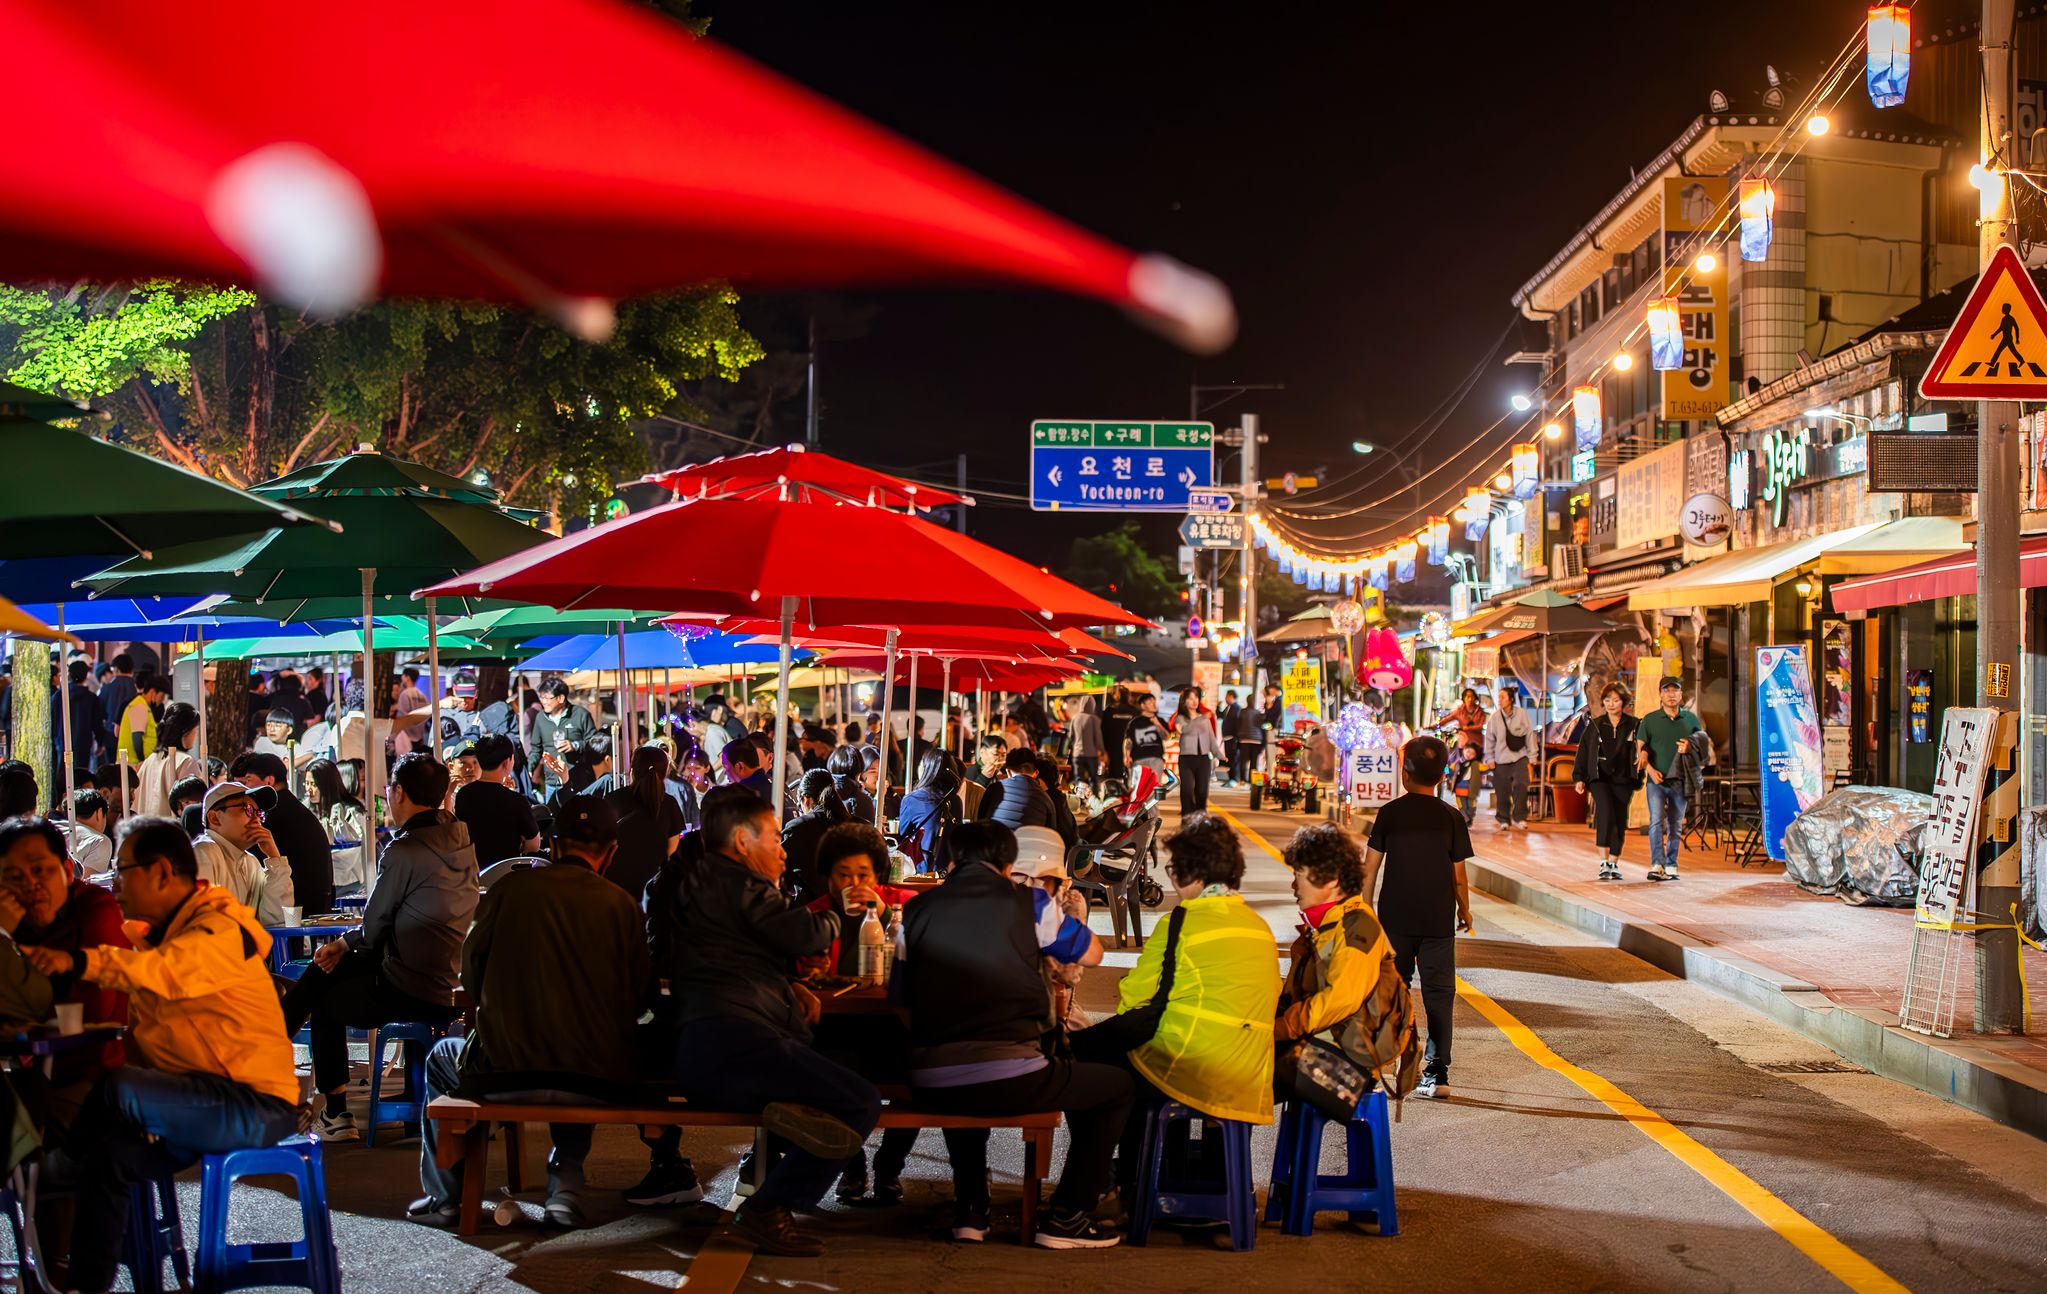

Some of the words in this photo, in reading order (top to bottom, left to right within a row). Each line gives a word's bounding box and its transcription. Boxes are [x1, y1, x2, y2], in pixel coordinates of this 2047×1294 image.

[1677, 276, 1718, 389] 노래방
[1080, 484, 1164, 500] Yocheon-ro
[1356, 755, 1393, 774] 풍선
[1356, 782, 1392, 801] 만원
